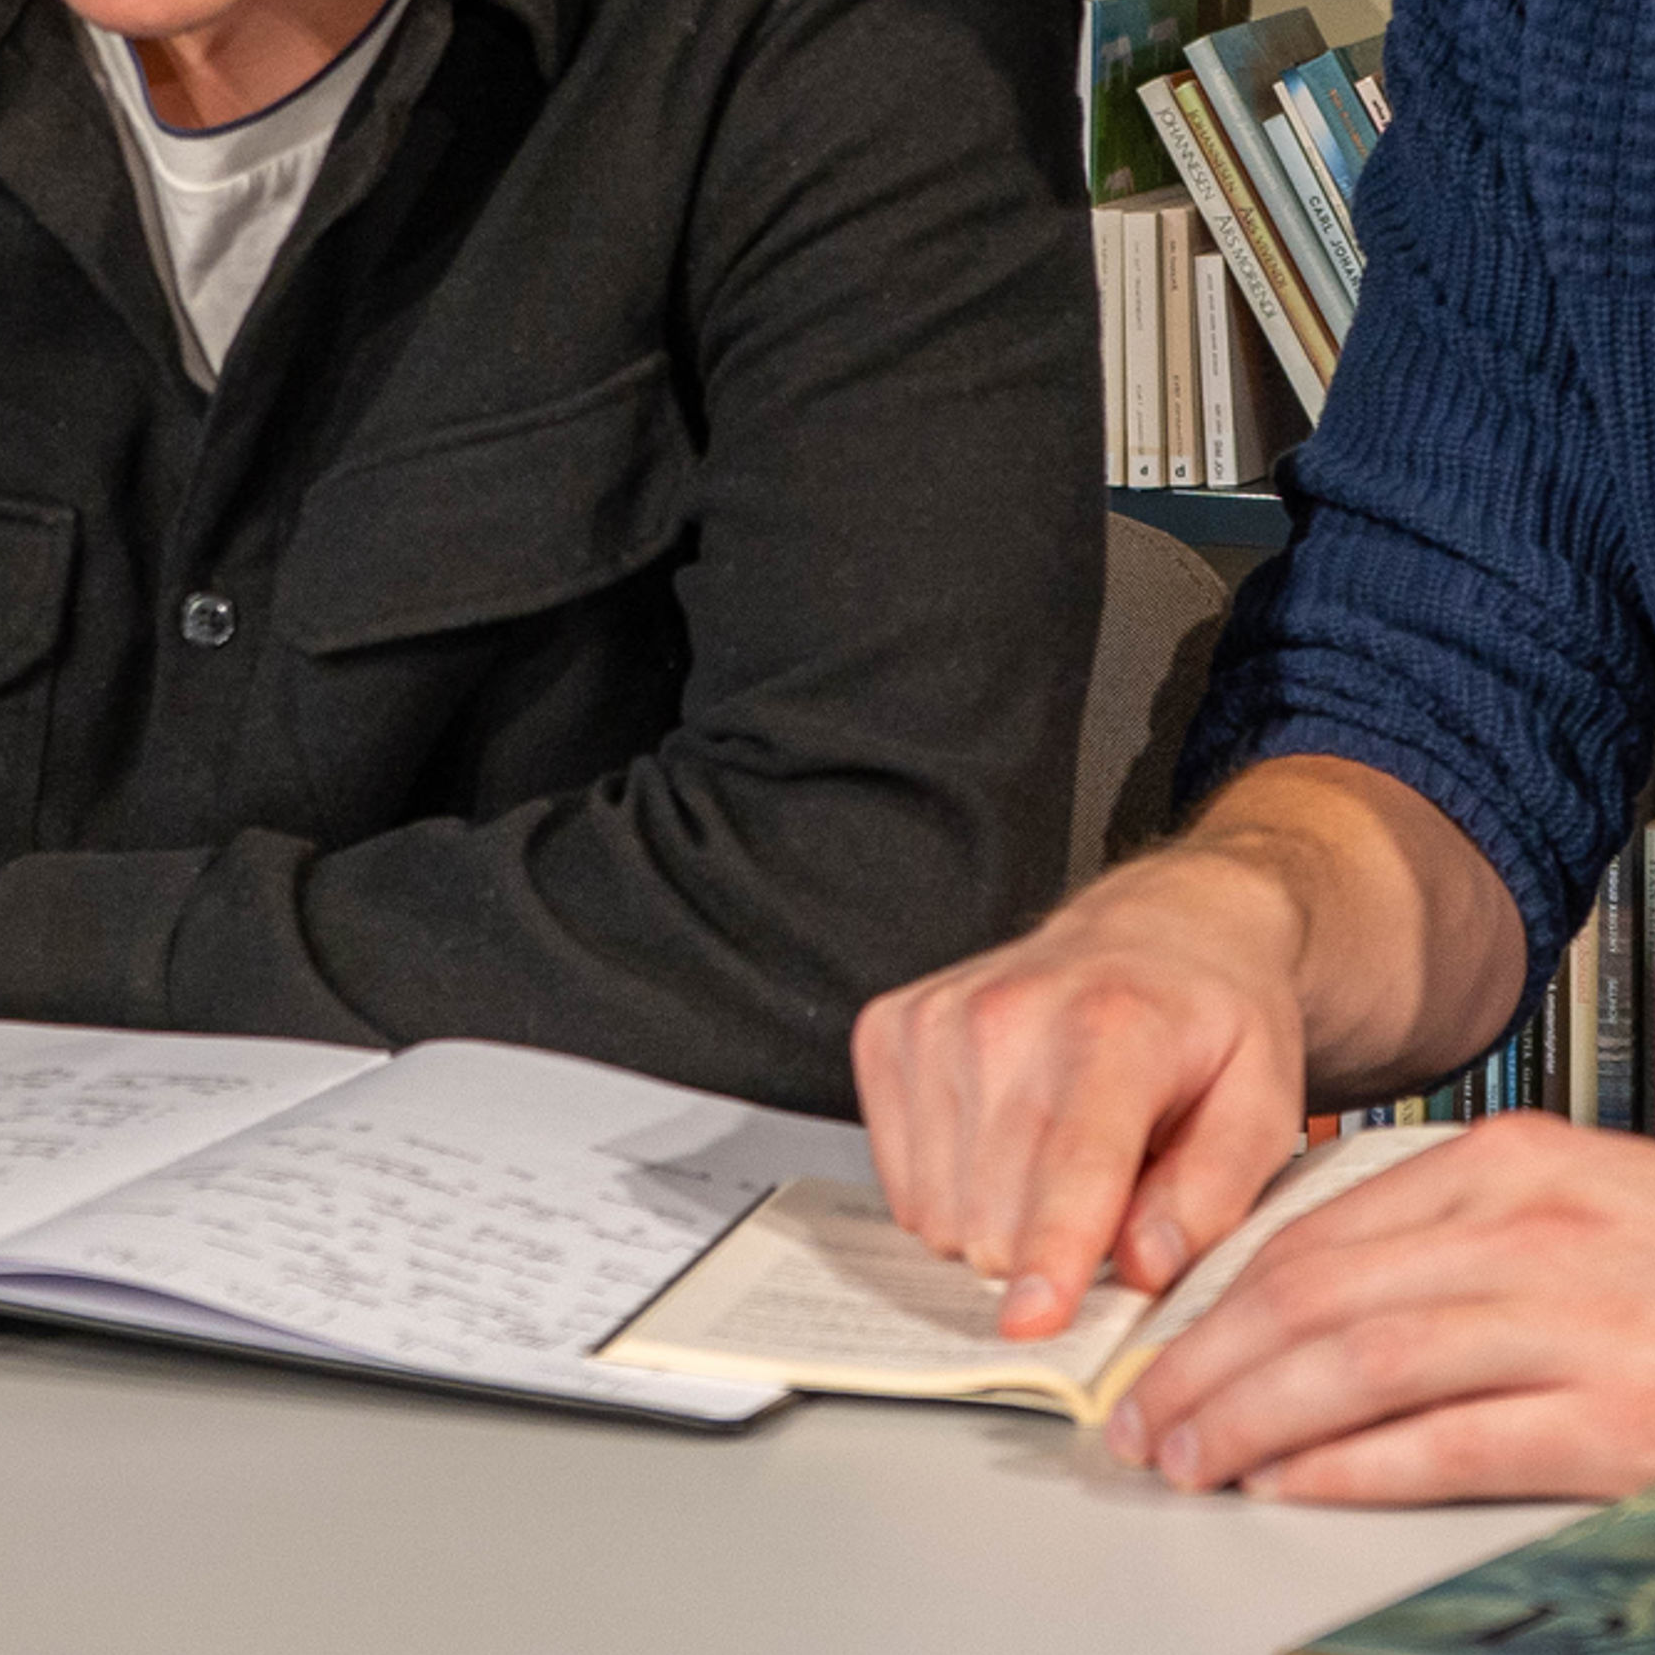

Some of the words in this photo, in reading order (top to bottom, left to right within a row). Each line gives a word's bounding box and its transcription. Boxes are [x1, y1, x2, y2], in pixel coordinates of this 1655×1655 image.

[1156, 107, 1216, 202] JOHANNESEN
[1213, 214, 1236, 248] ARS
[1308, 195, 1333, 235] CARL
[1329, 238, 1361, 295] JOHAN
